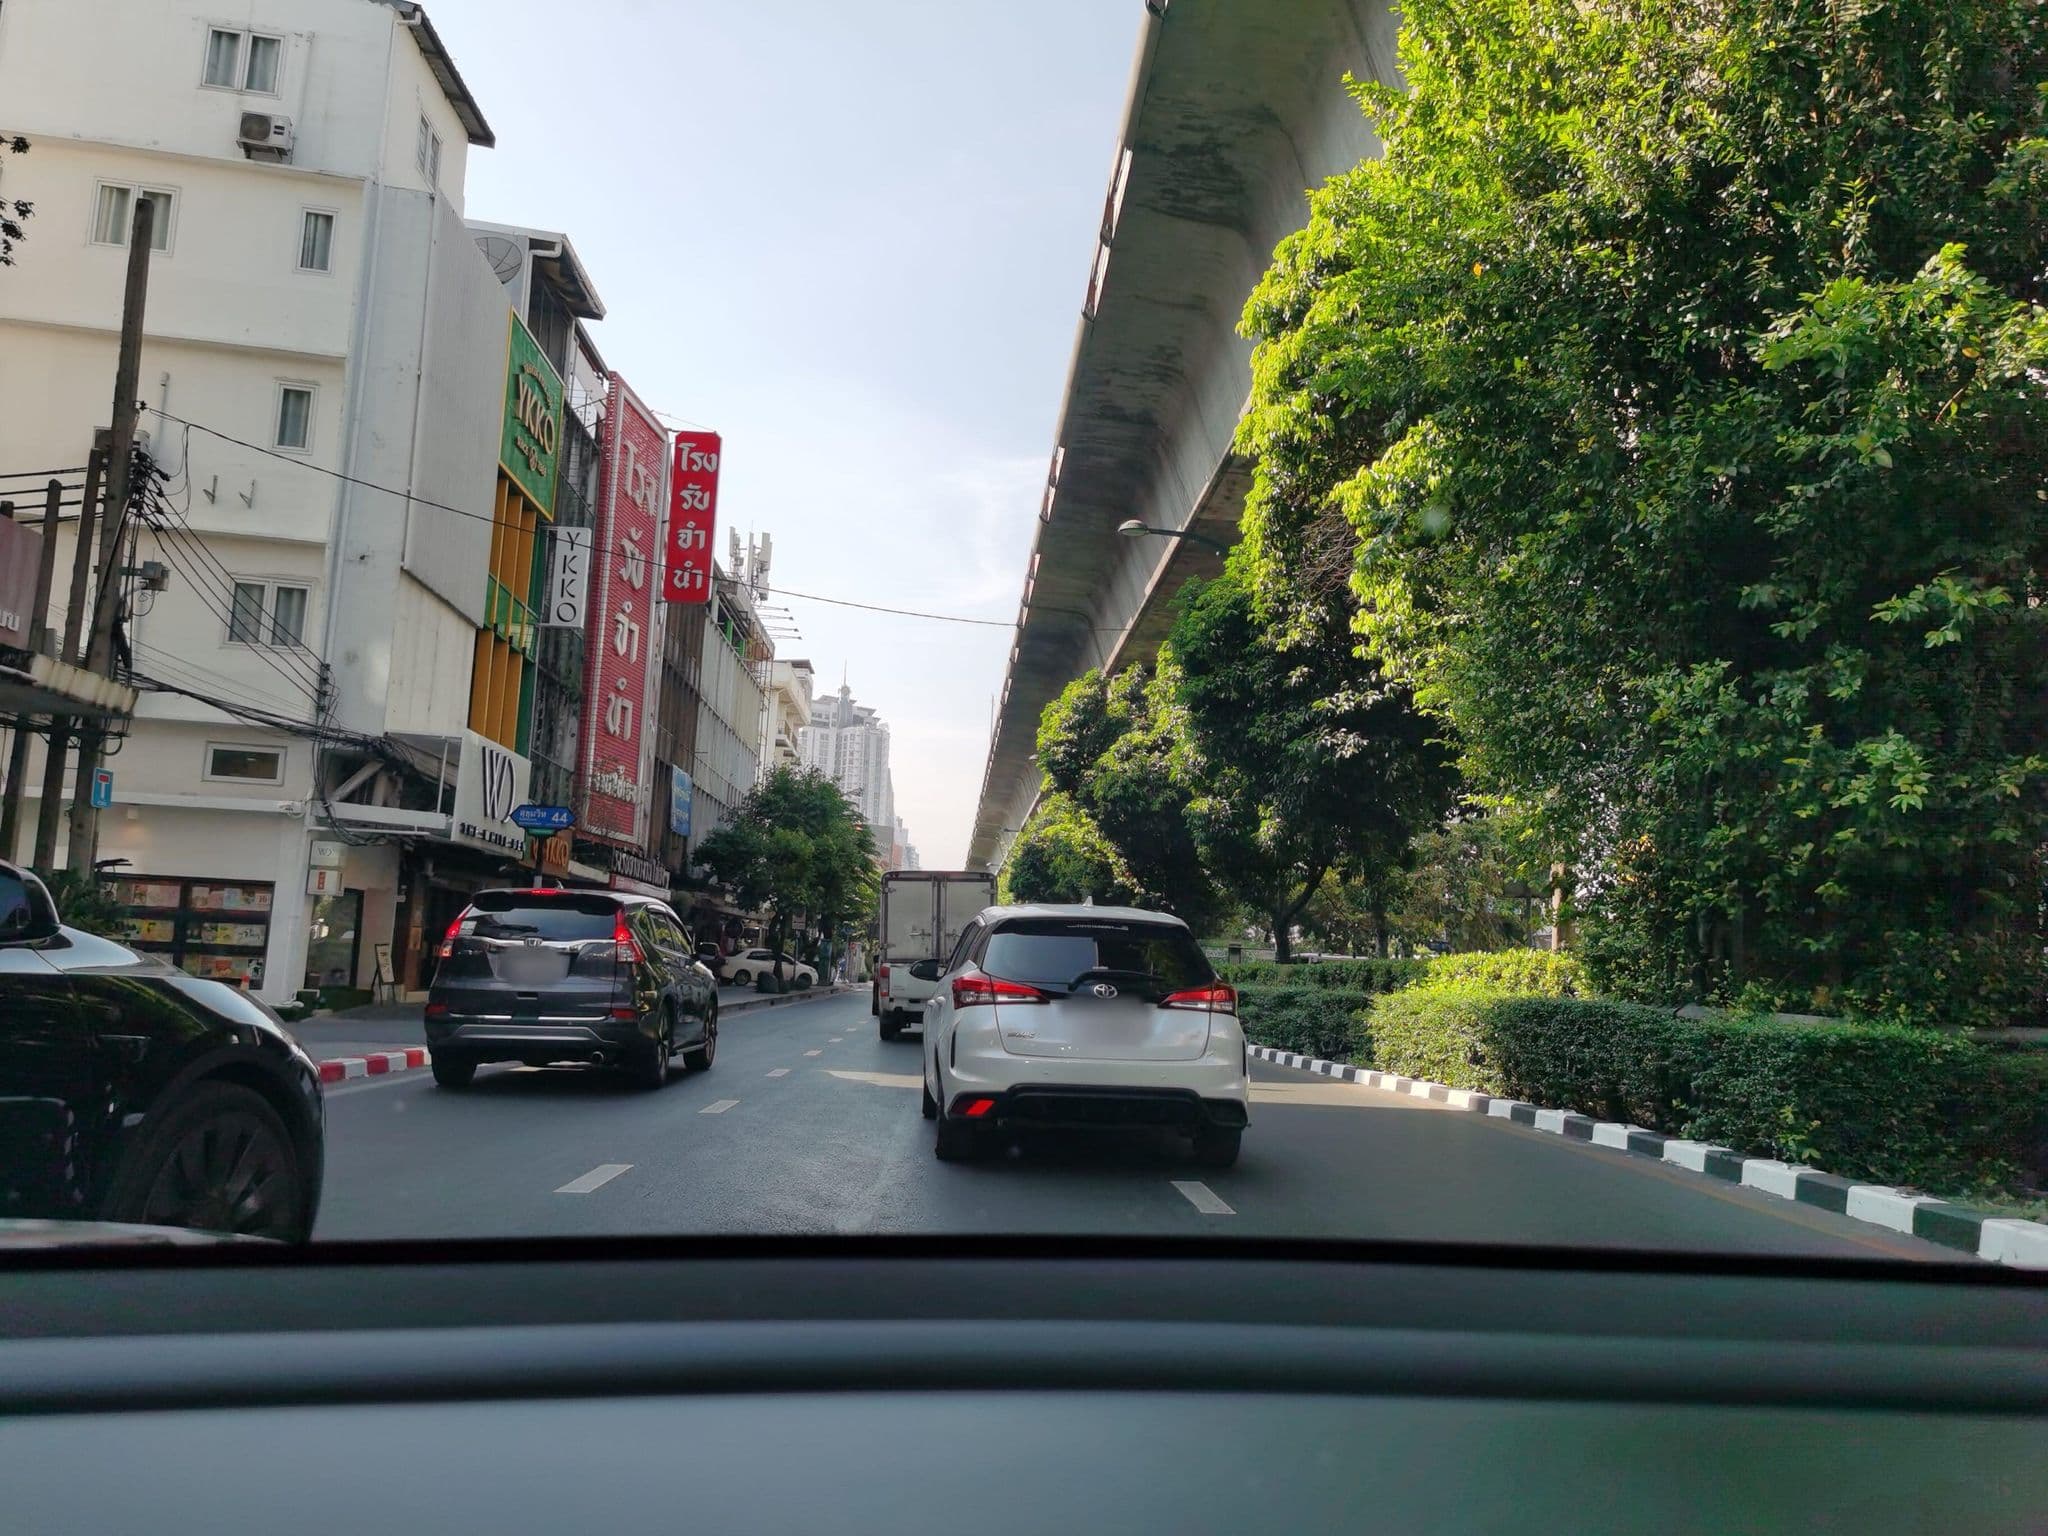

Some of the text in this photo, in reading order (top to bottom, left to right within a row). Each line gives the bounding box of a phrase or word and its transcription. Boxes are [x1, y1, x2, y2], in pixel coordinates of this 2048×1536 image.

[517, 374, 555, 456] YKKO
[624, 440, 658, 517] โรง
[677, 442, 718, 473] โรง
[680, 483, 710, 511] รับ
[619, 527, 646, 590] รับ
[677, 521, 706, 549] จำ
[556, 531, 578, 622] YKKO
[673, 561, 703, 589] นำ
[613, 600, 640, 664] จำ
[605, 676, 633, 741] นำ
[551, 811, 568, 823] 44
